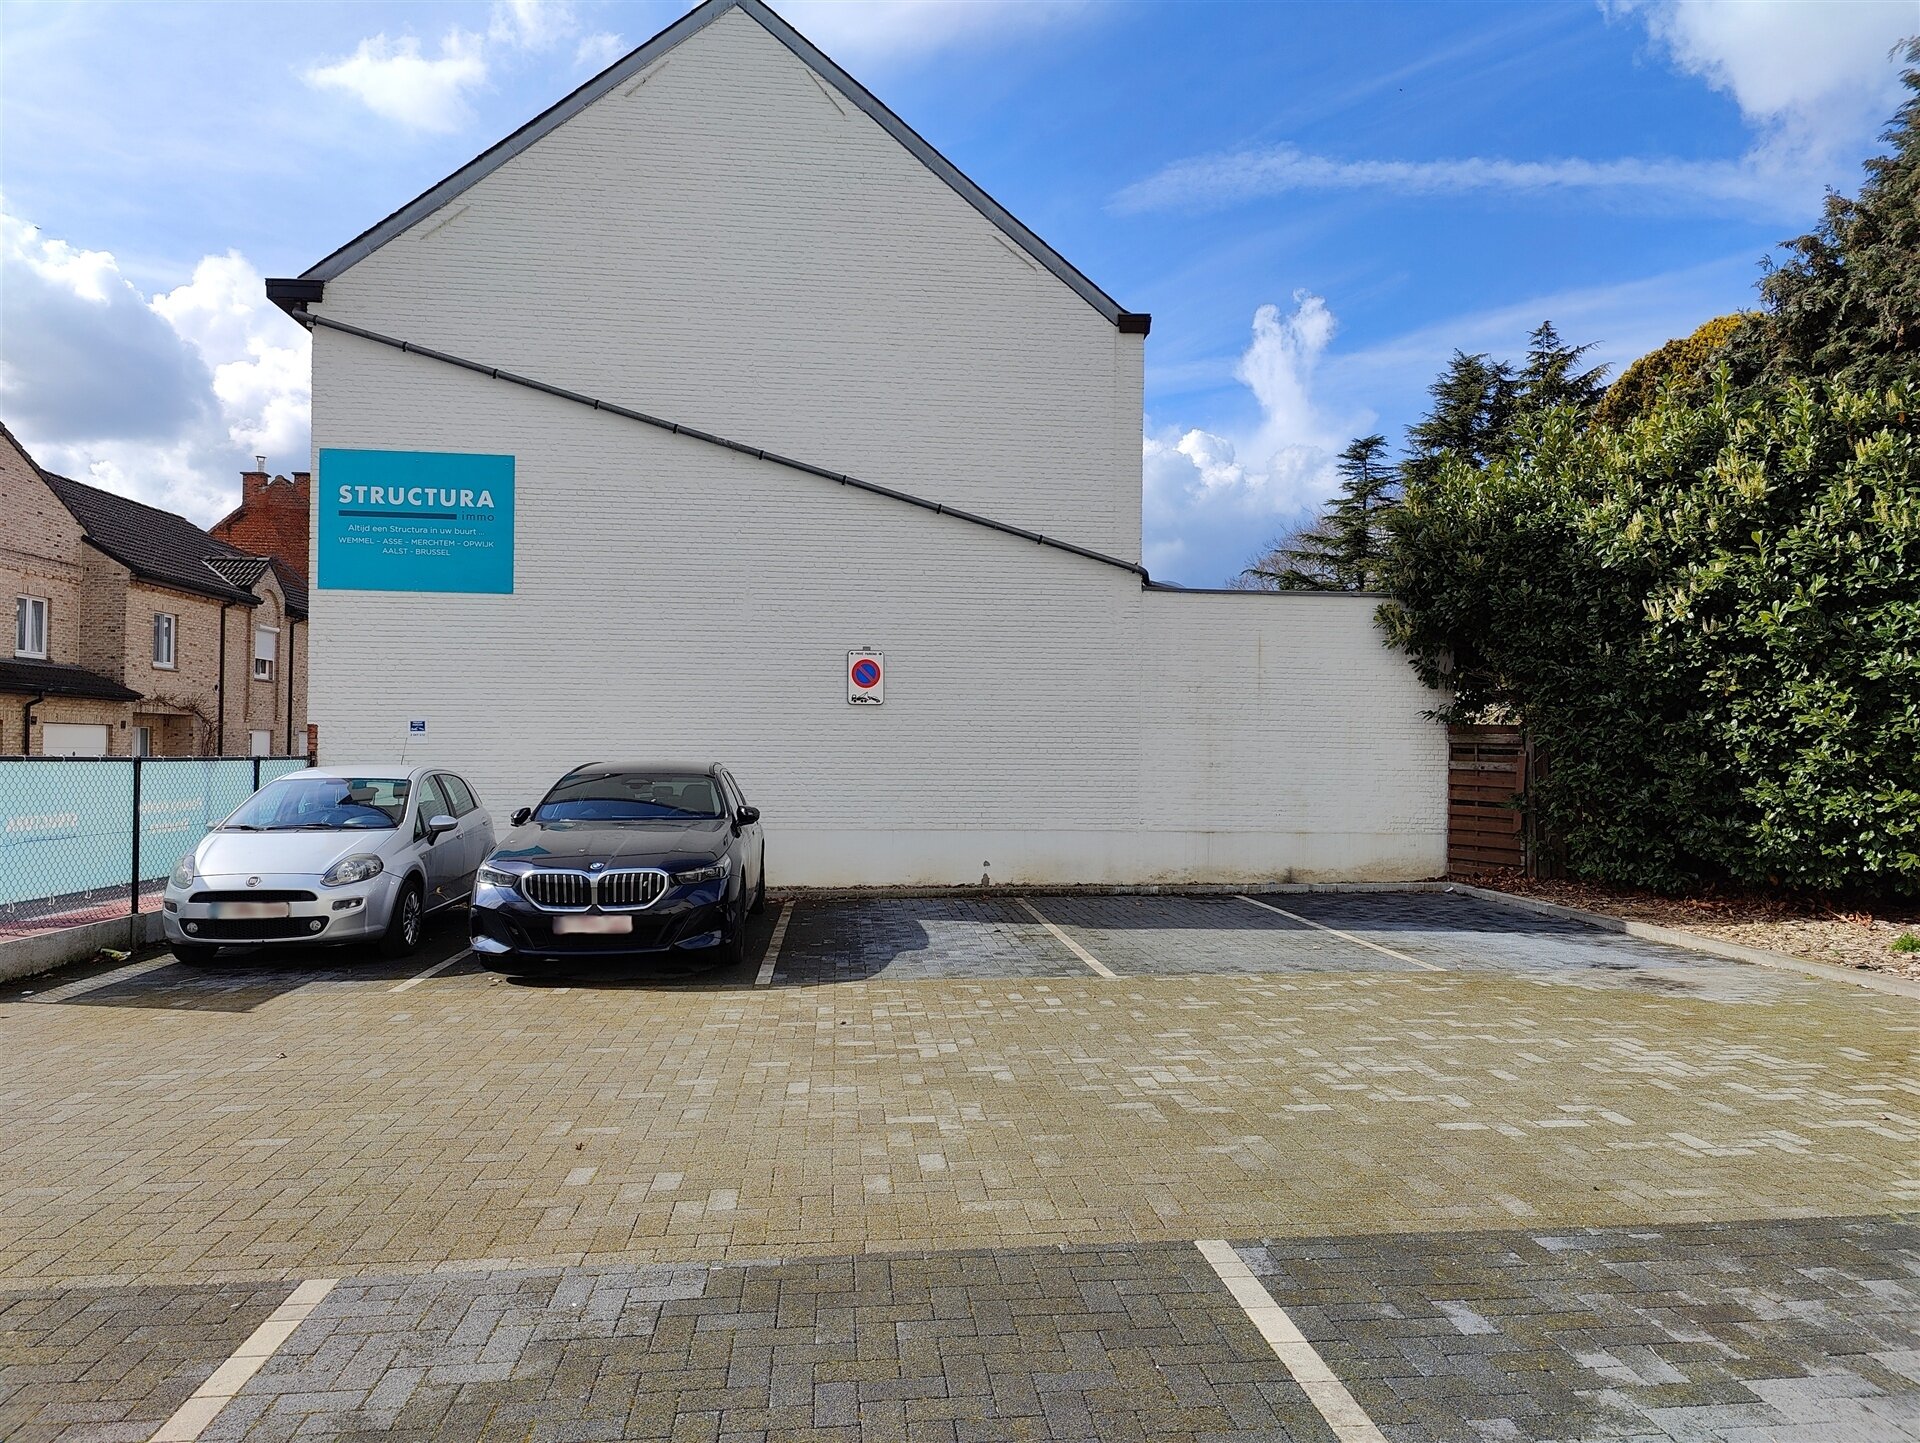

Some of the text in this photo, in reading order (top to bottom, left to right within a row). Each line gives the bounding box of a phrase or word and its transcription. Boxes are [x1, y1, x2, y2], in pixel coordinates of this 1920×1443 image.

[338, 484, 495, 508] STRUCTURA
[461, 510, 495, 522] immo
[348, 524, 370, 533] Altijd
[389, 525, 428, 534] Structura
[415, 548, 451, 556] BRUSSEL
